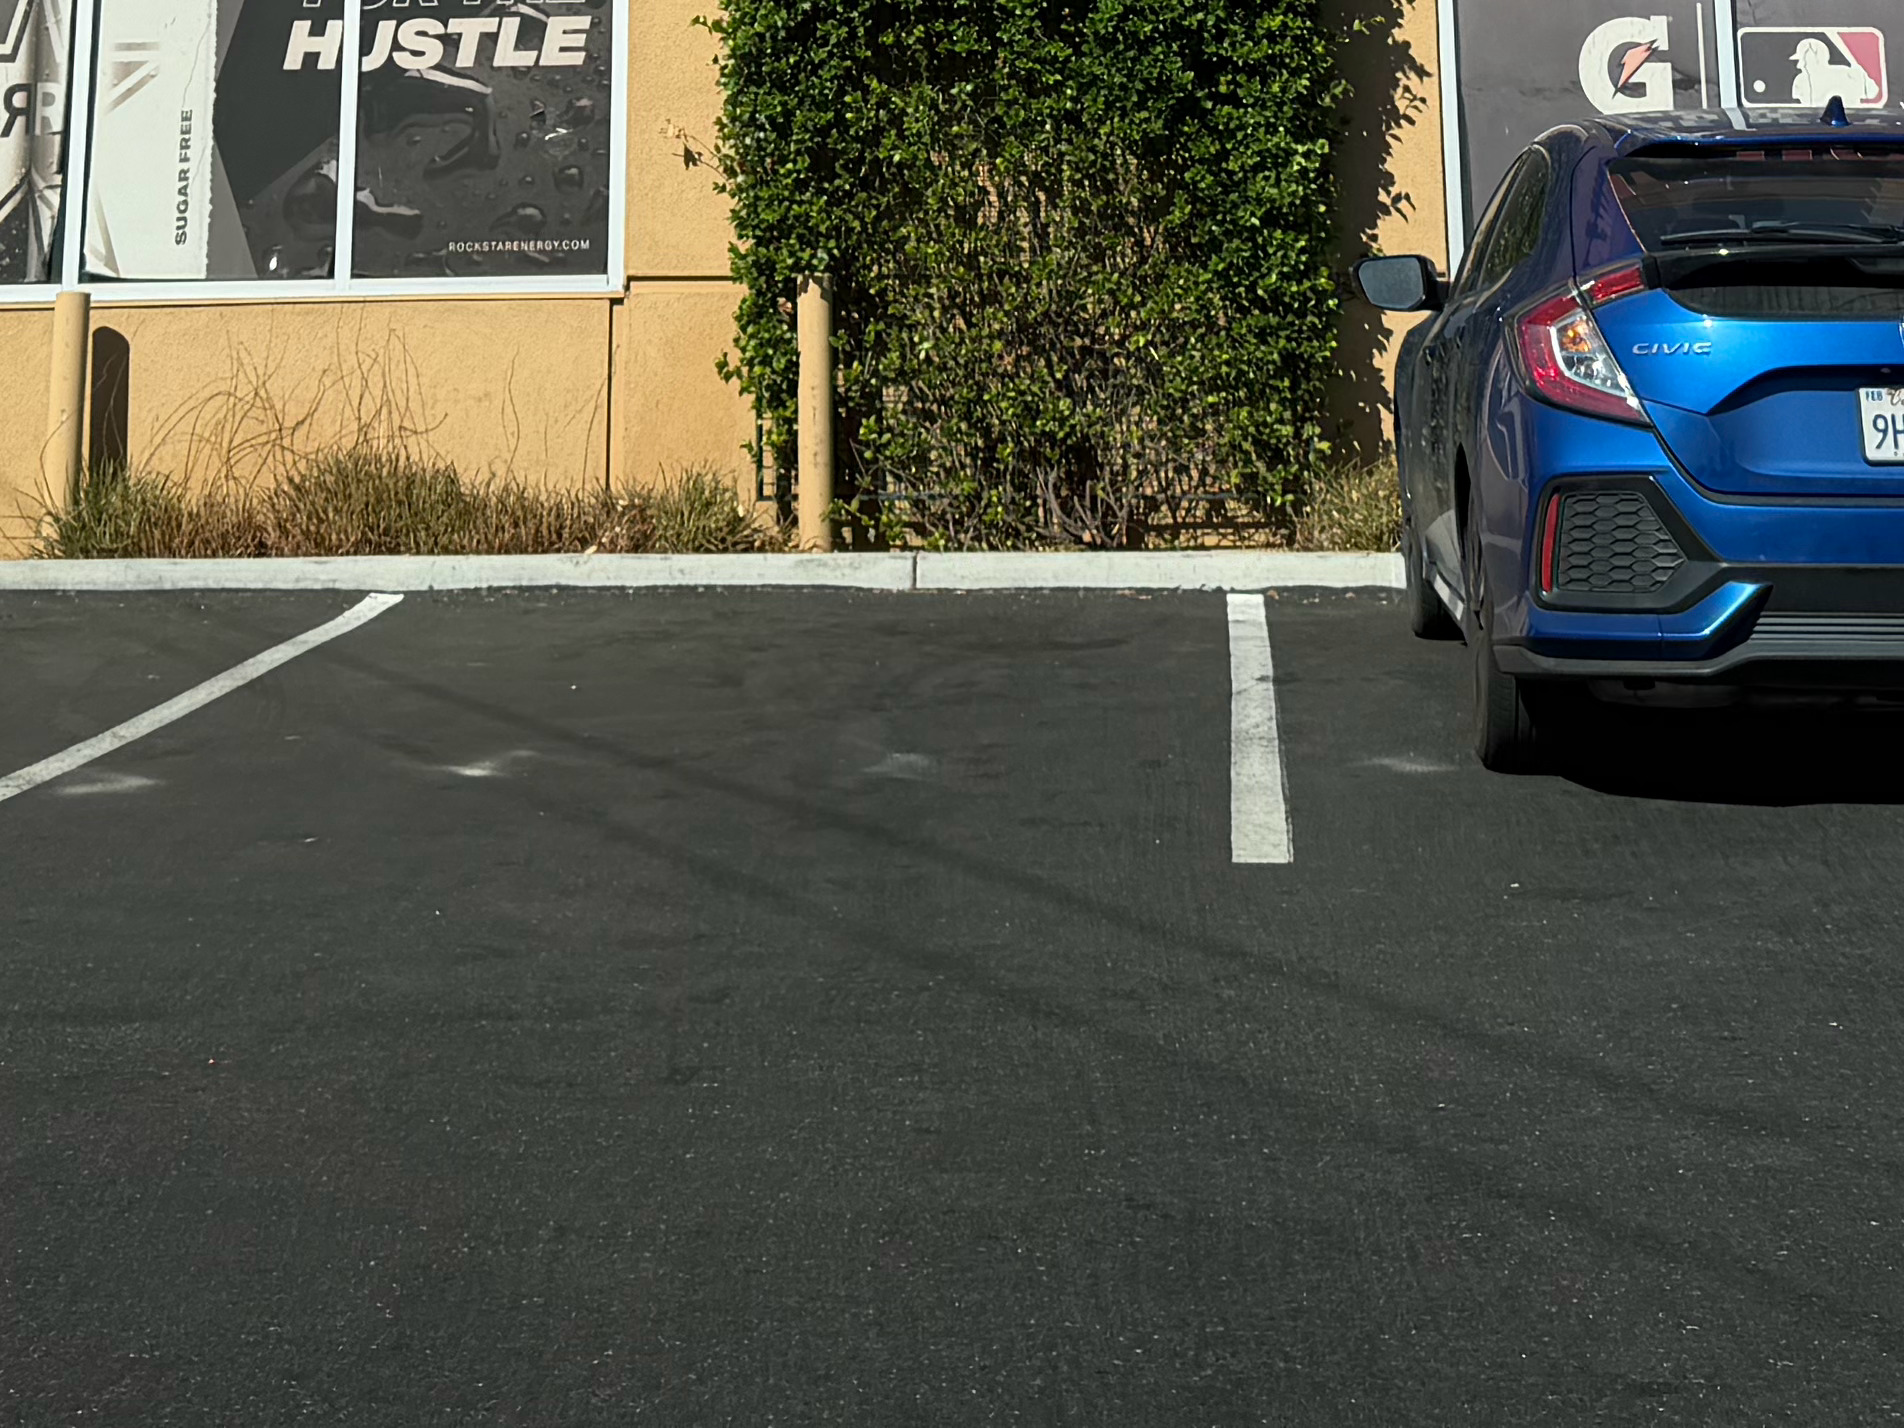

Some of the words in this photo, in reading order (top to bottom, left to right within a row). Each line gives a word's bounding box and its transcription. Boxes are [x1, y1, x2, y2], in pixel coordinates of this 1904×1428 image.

[179, 109, 193, 168] FREE
[175, 171, 192, 246] SUGAR
[448, 239, 590, 253] ROCKSTARENERGY.COM
[1632, 341, 1712, 355] CIVIC
